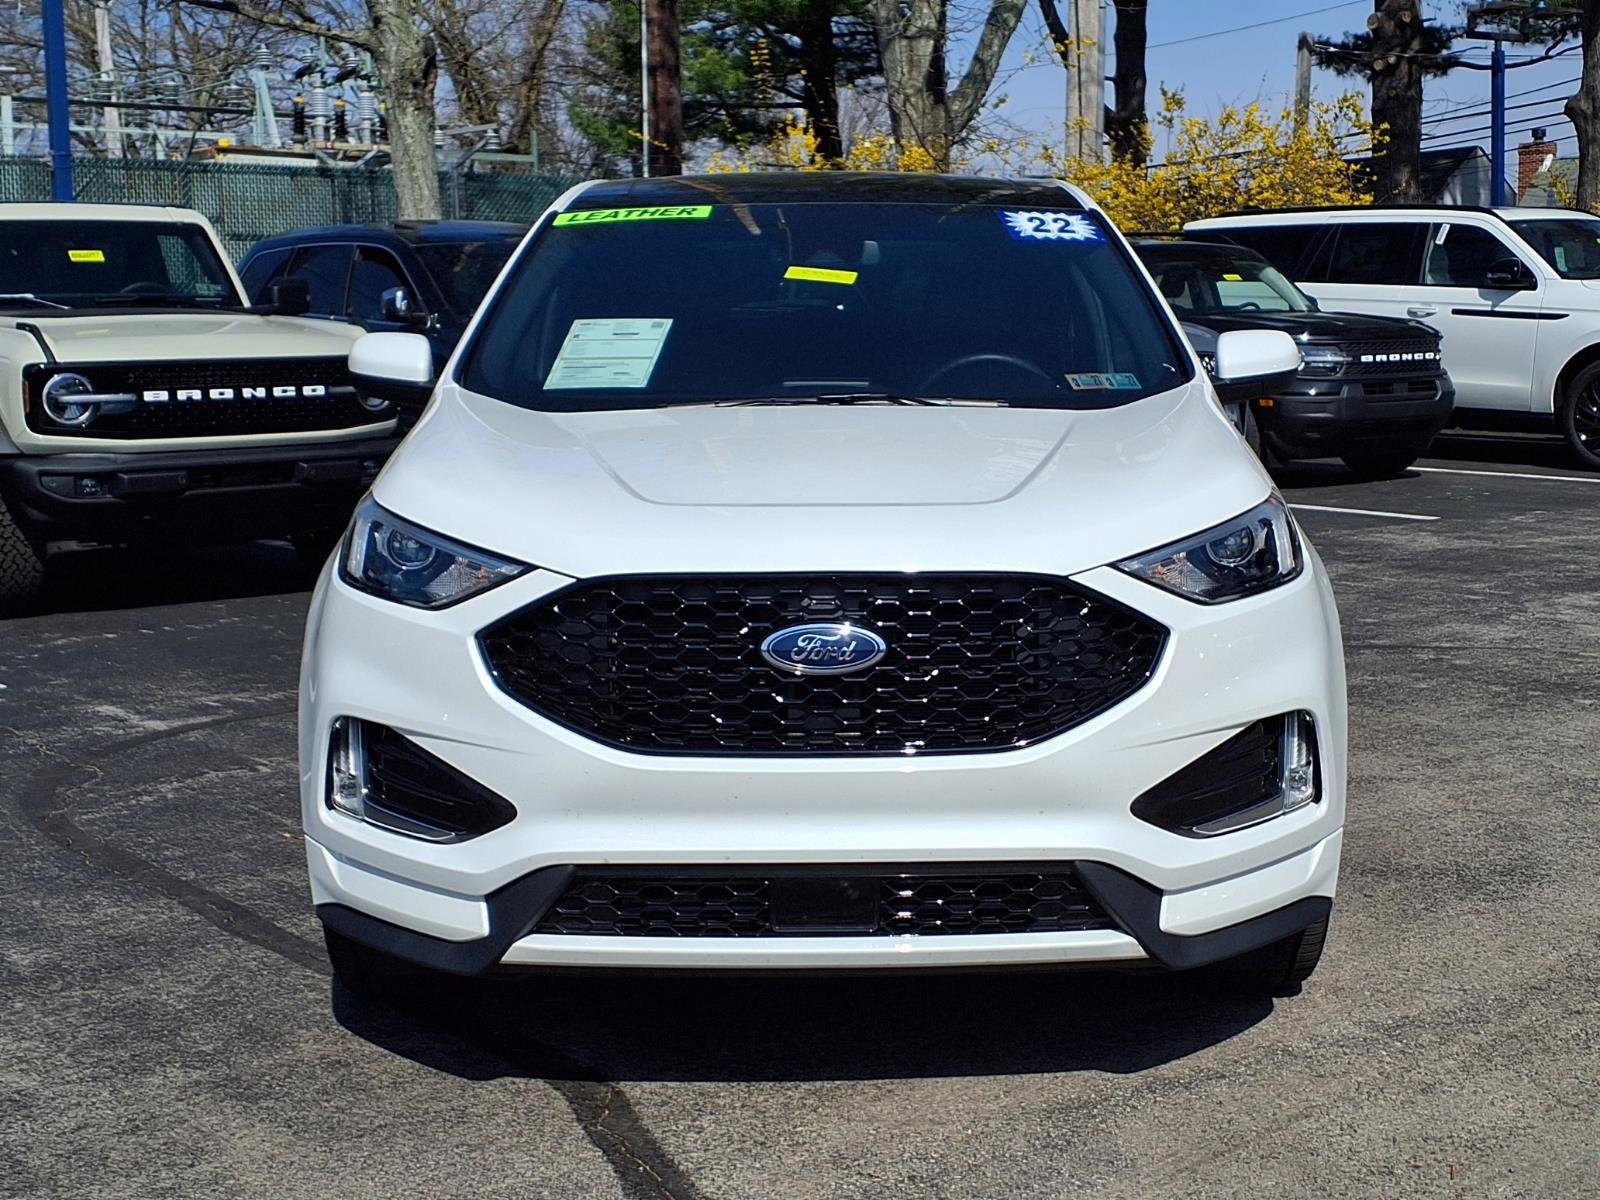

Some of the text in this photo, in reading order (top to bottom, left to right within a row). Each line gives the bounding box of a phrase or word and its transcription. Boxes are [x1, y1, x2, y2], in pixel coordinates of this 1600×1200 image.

[566, 207, 699, 222] LEATHER
[1027, 216, 1076, 233] 22
[1361, 352, 1435, 363] BRONCO
[143, 385, 326, 402] BRONCO
[791, 634, 857, 661] Ford
